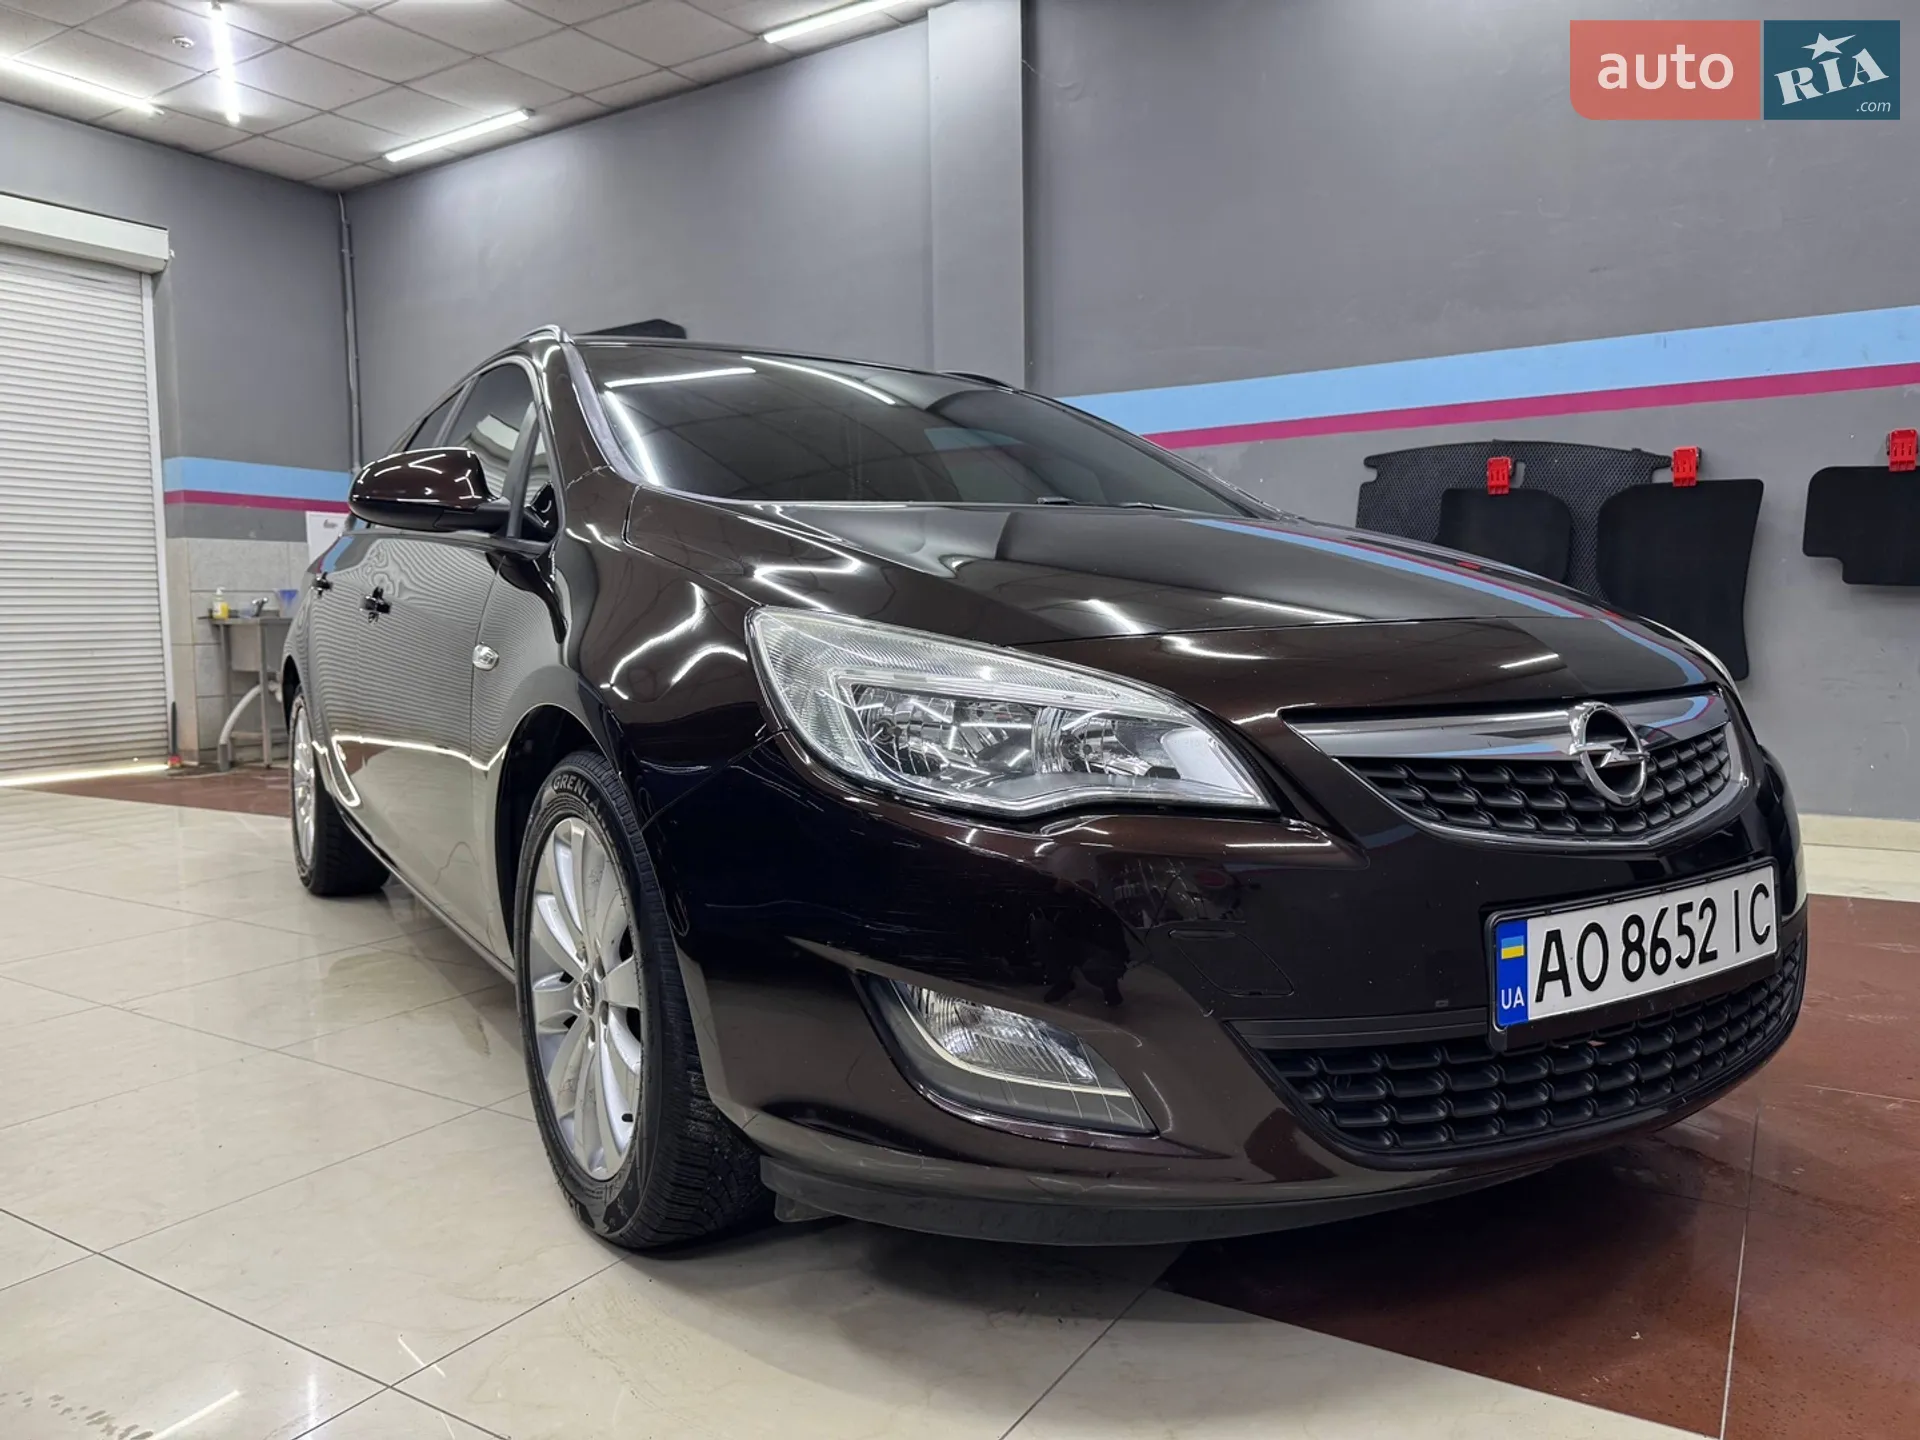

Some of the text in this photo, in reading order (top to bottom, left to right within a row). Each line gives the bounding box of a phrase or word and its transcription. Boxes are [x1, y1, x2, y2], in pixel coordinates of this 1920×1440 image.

[1534, 882, 1771, 1004] AO 8652 IC
[1501, 985, 1525, 1010] UA
